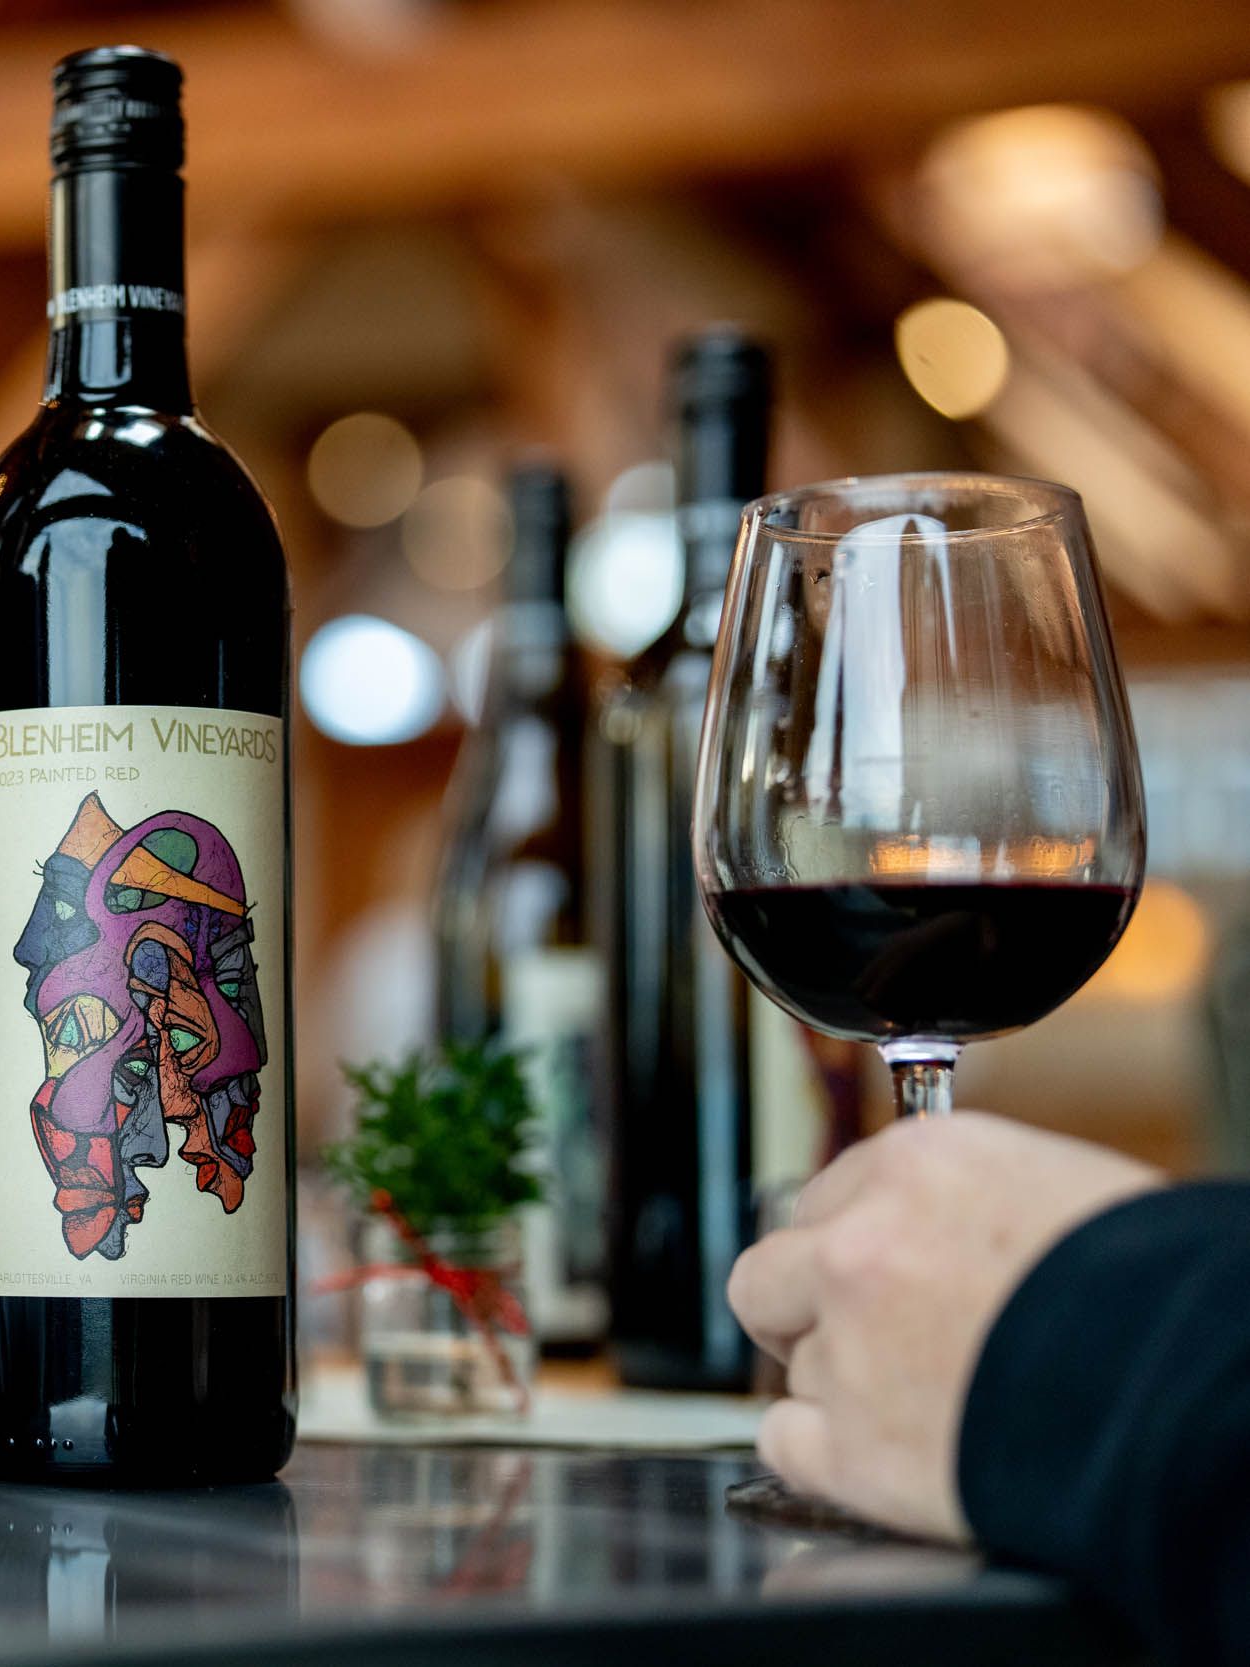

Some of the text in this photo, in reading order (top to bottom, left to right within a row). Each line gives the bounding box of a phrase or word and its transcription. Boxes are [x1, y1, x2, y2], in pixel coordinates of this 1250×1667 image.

[150, 717, 278, 764] VINEYARDS
[29, 766, 97, 785] PAINTED
[104, 766, 141, 782] RED
[119, 1272, 168, 1286] VIRGINIA
[170, 1273, 192, 1286] RED
[195, 1273, 220, 1286] WINE
